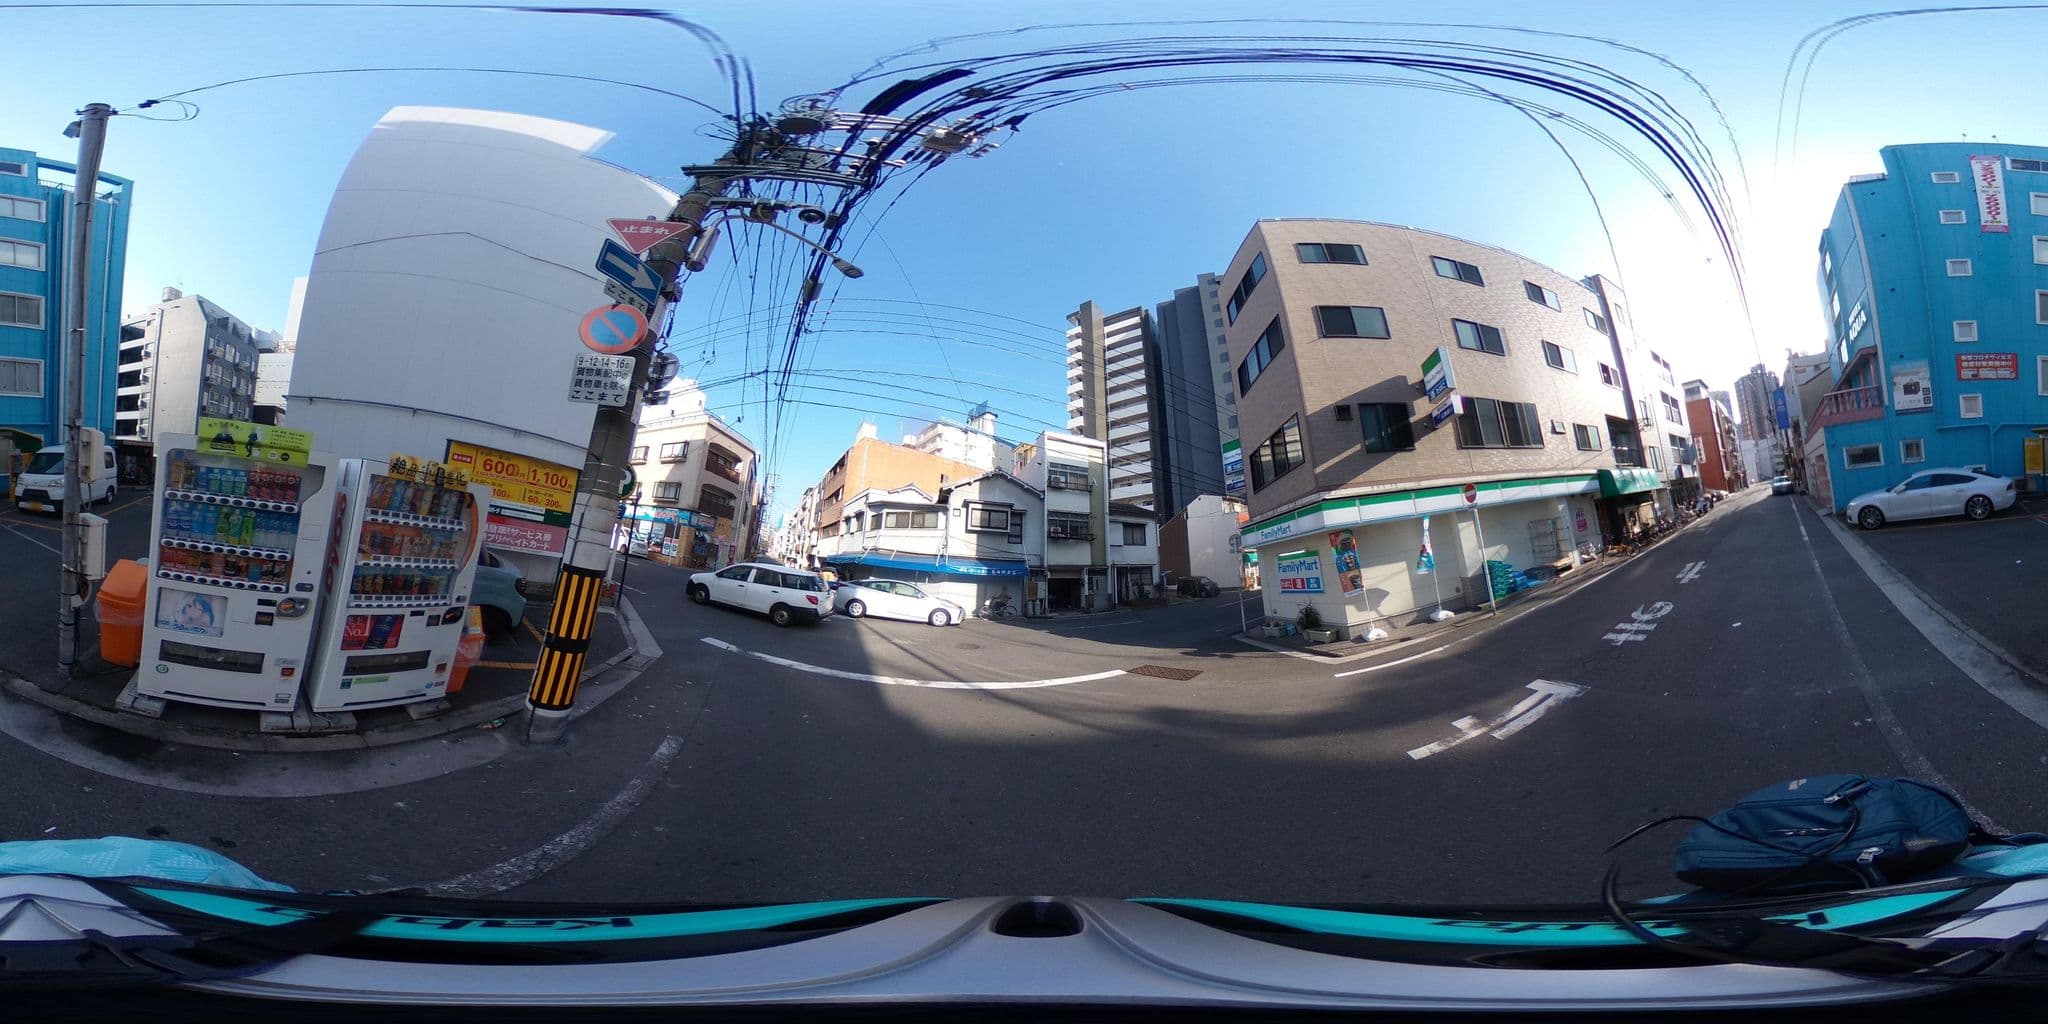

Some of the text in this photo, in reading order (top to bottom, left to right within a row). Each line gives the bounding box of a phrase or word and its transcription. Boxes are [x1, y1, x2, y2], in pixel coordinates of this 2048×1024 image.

[621, 225, 670, 235] 止まれ
[606, 283, 646, 311] ここまで
[571, 390, 624, 403] ここまで
[1260, 524, 1291, 540] FamilyMart
[1277, 558, 1319, 576] FamilyMart
